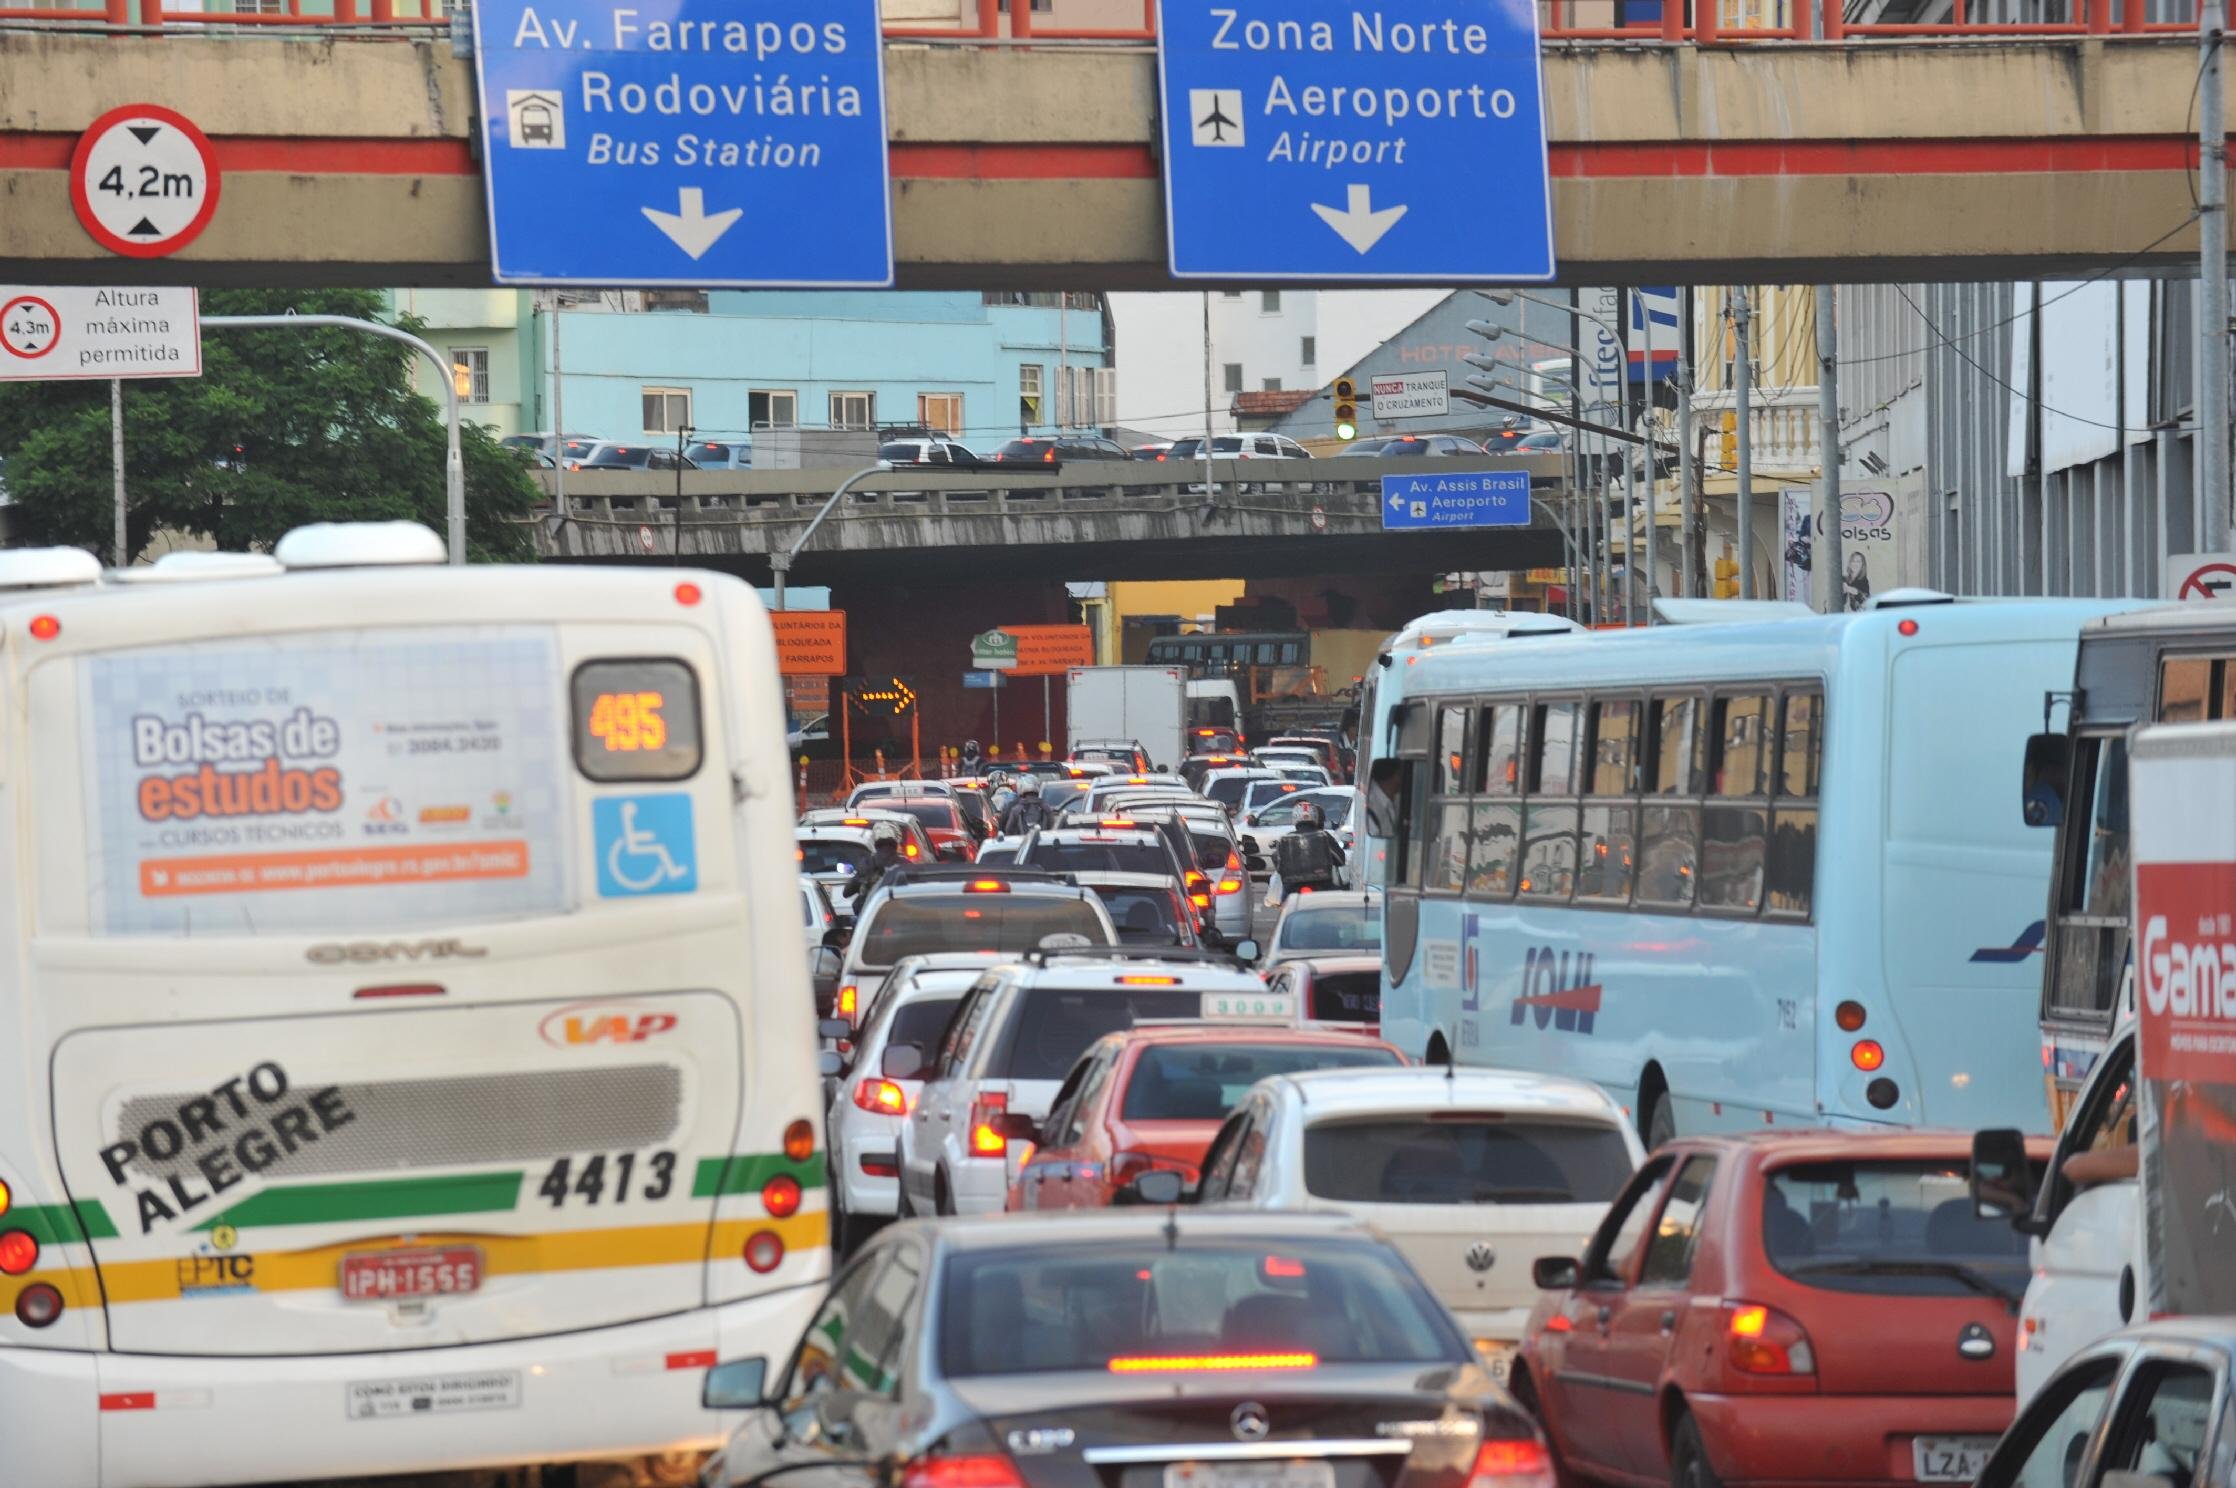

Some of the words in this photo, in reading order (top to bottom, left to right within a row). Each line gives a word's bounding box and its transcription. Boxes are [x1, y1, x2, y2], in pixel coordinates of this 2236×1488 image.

[513, 7, 592, 49] Av.
[612, 8, 847, 62] Farrapos
[1210, 9, 1333, 51] Zona
[1352, 11, 1488, 54] Norte
[581, 71, 863, 117] Rodoviária
[1264, 75, 1516, 127] Aeroporto
[587, 133, 661, 166] Bus
[673, 133, 822, 168] Station
[1267, 131, 1407, 169] Airport
[99, 165, 193, 200] 4,2m
[95, 289, 159, 307] Altura
[85, 316, 170, 335] máxima
[80, 344, 180, 367] permitida
[1589, 329, 1618, 387] ftec
[1373, 383, 1404, 395] NUNCA
[1406, 380, 1446, 392] TRANQUE
[1377, 400, 1385, 410] O
[1386, 397, 1444, 410] CRUZAMENTO
[1409, 480, 1432, 493] Av.
[1436, 479, 1478, 492] Assis
[1482, 477, 1525, 491] Brasil
[1432, 495, 1507, 509] Aeroporto
[1432, 511, 1475, 522] Airport
[1841, 526, 1892, 541] olsas
[133, 712, 277, 767] Bolsas
[281, 706, 340, 759] de
[589, 691, 667, 752] 495
[138, 756, 344, 821] estudos
[159, 827, 241, 847] CURSOS
[100, 1061, 289, 1186] PORTO
[137, 1086, 356, 1235] ALEGRE
[538, 1151, 677, 1207] 4413
